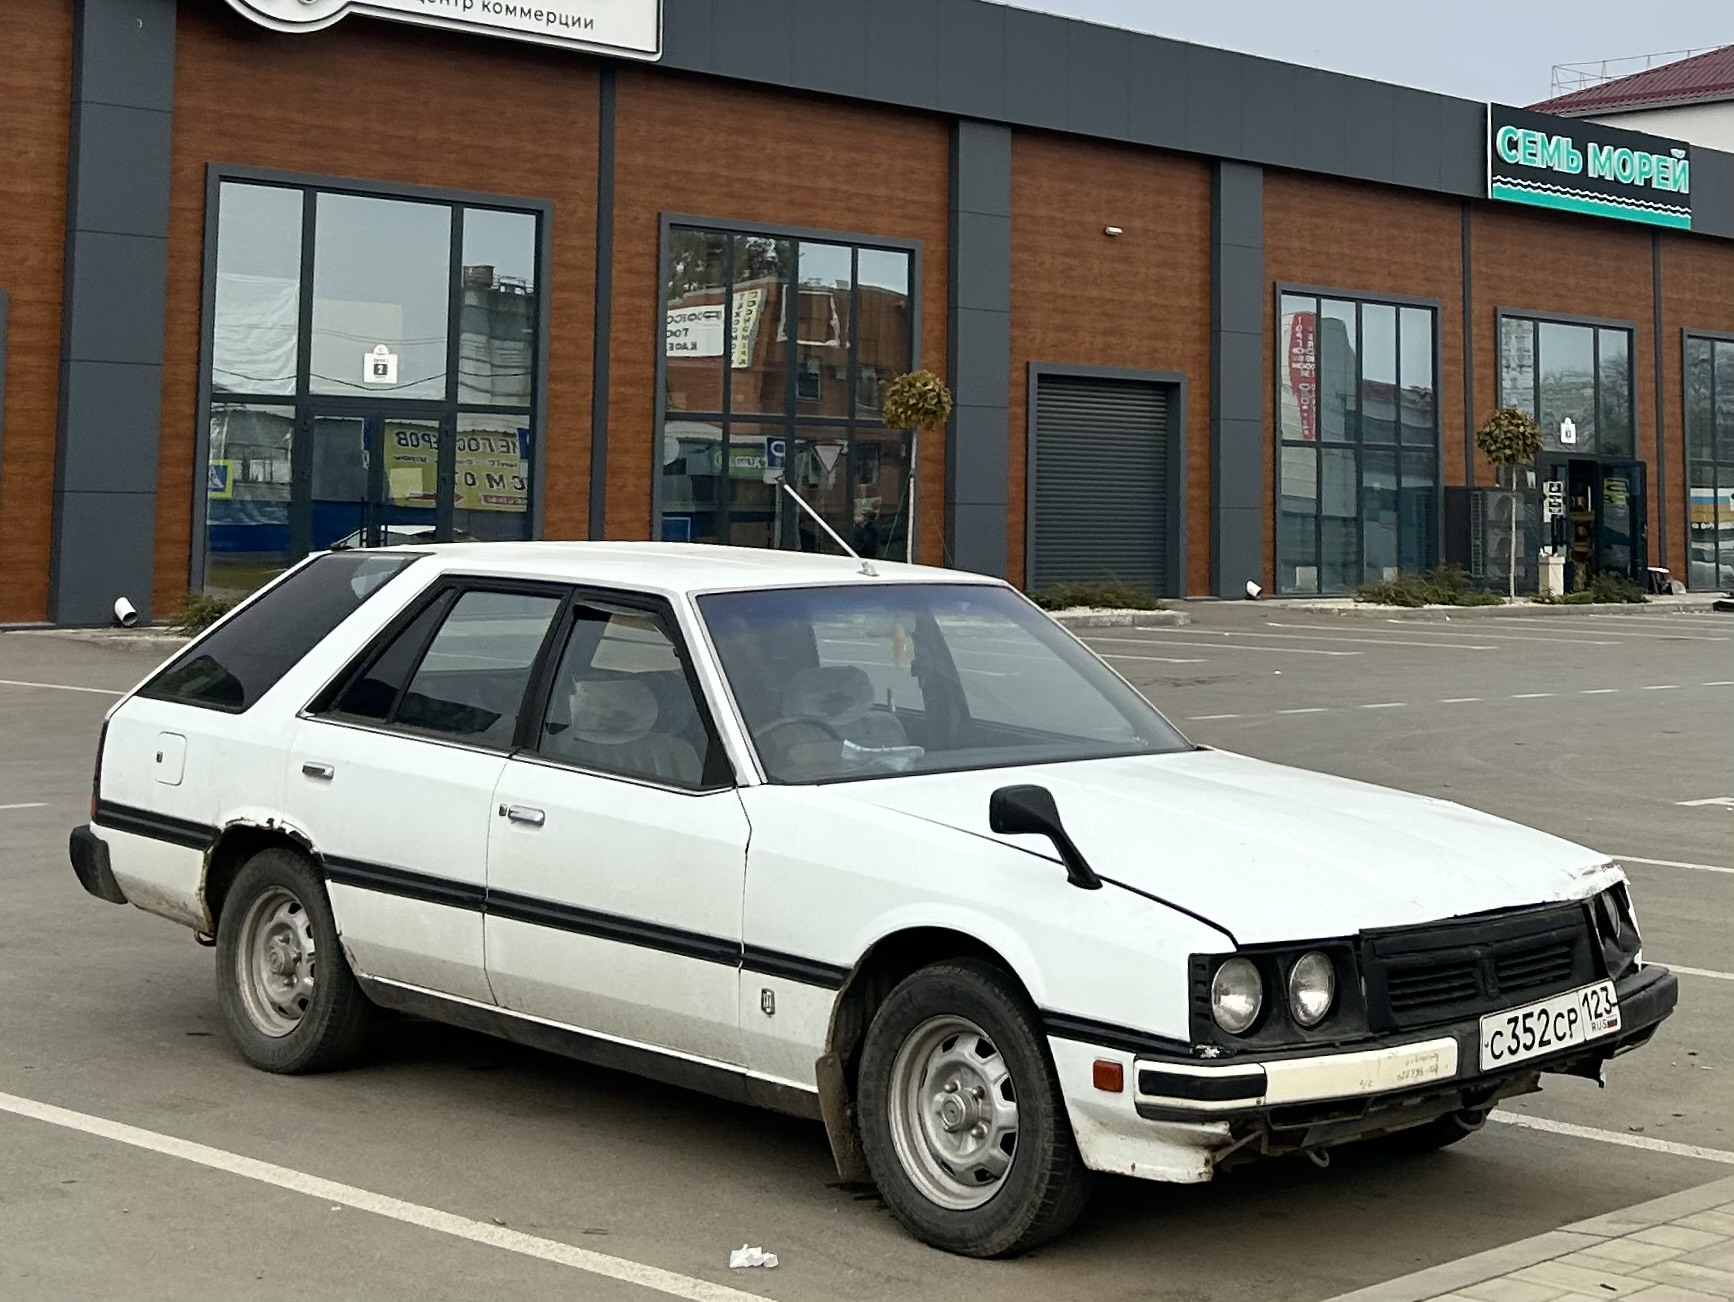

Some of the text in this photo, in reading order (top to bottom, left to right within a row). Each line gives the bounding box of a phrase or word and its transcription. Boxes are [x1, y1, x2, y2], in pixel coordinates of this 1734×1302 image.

[482, 1, 594, 30] коммерции
[1496, 125, 1689, 194] СЕМЬ МОРЕЙ
[1582, 986, 1613, 1022] 123
[1591, 1018, 1608, 1032] RUS
